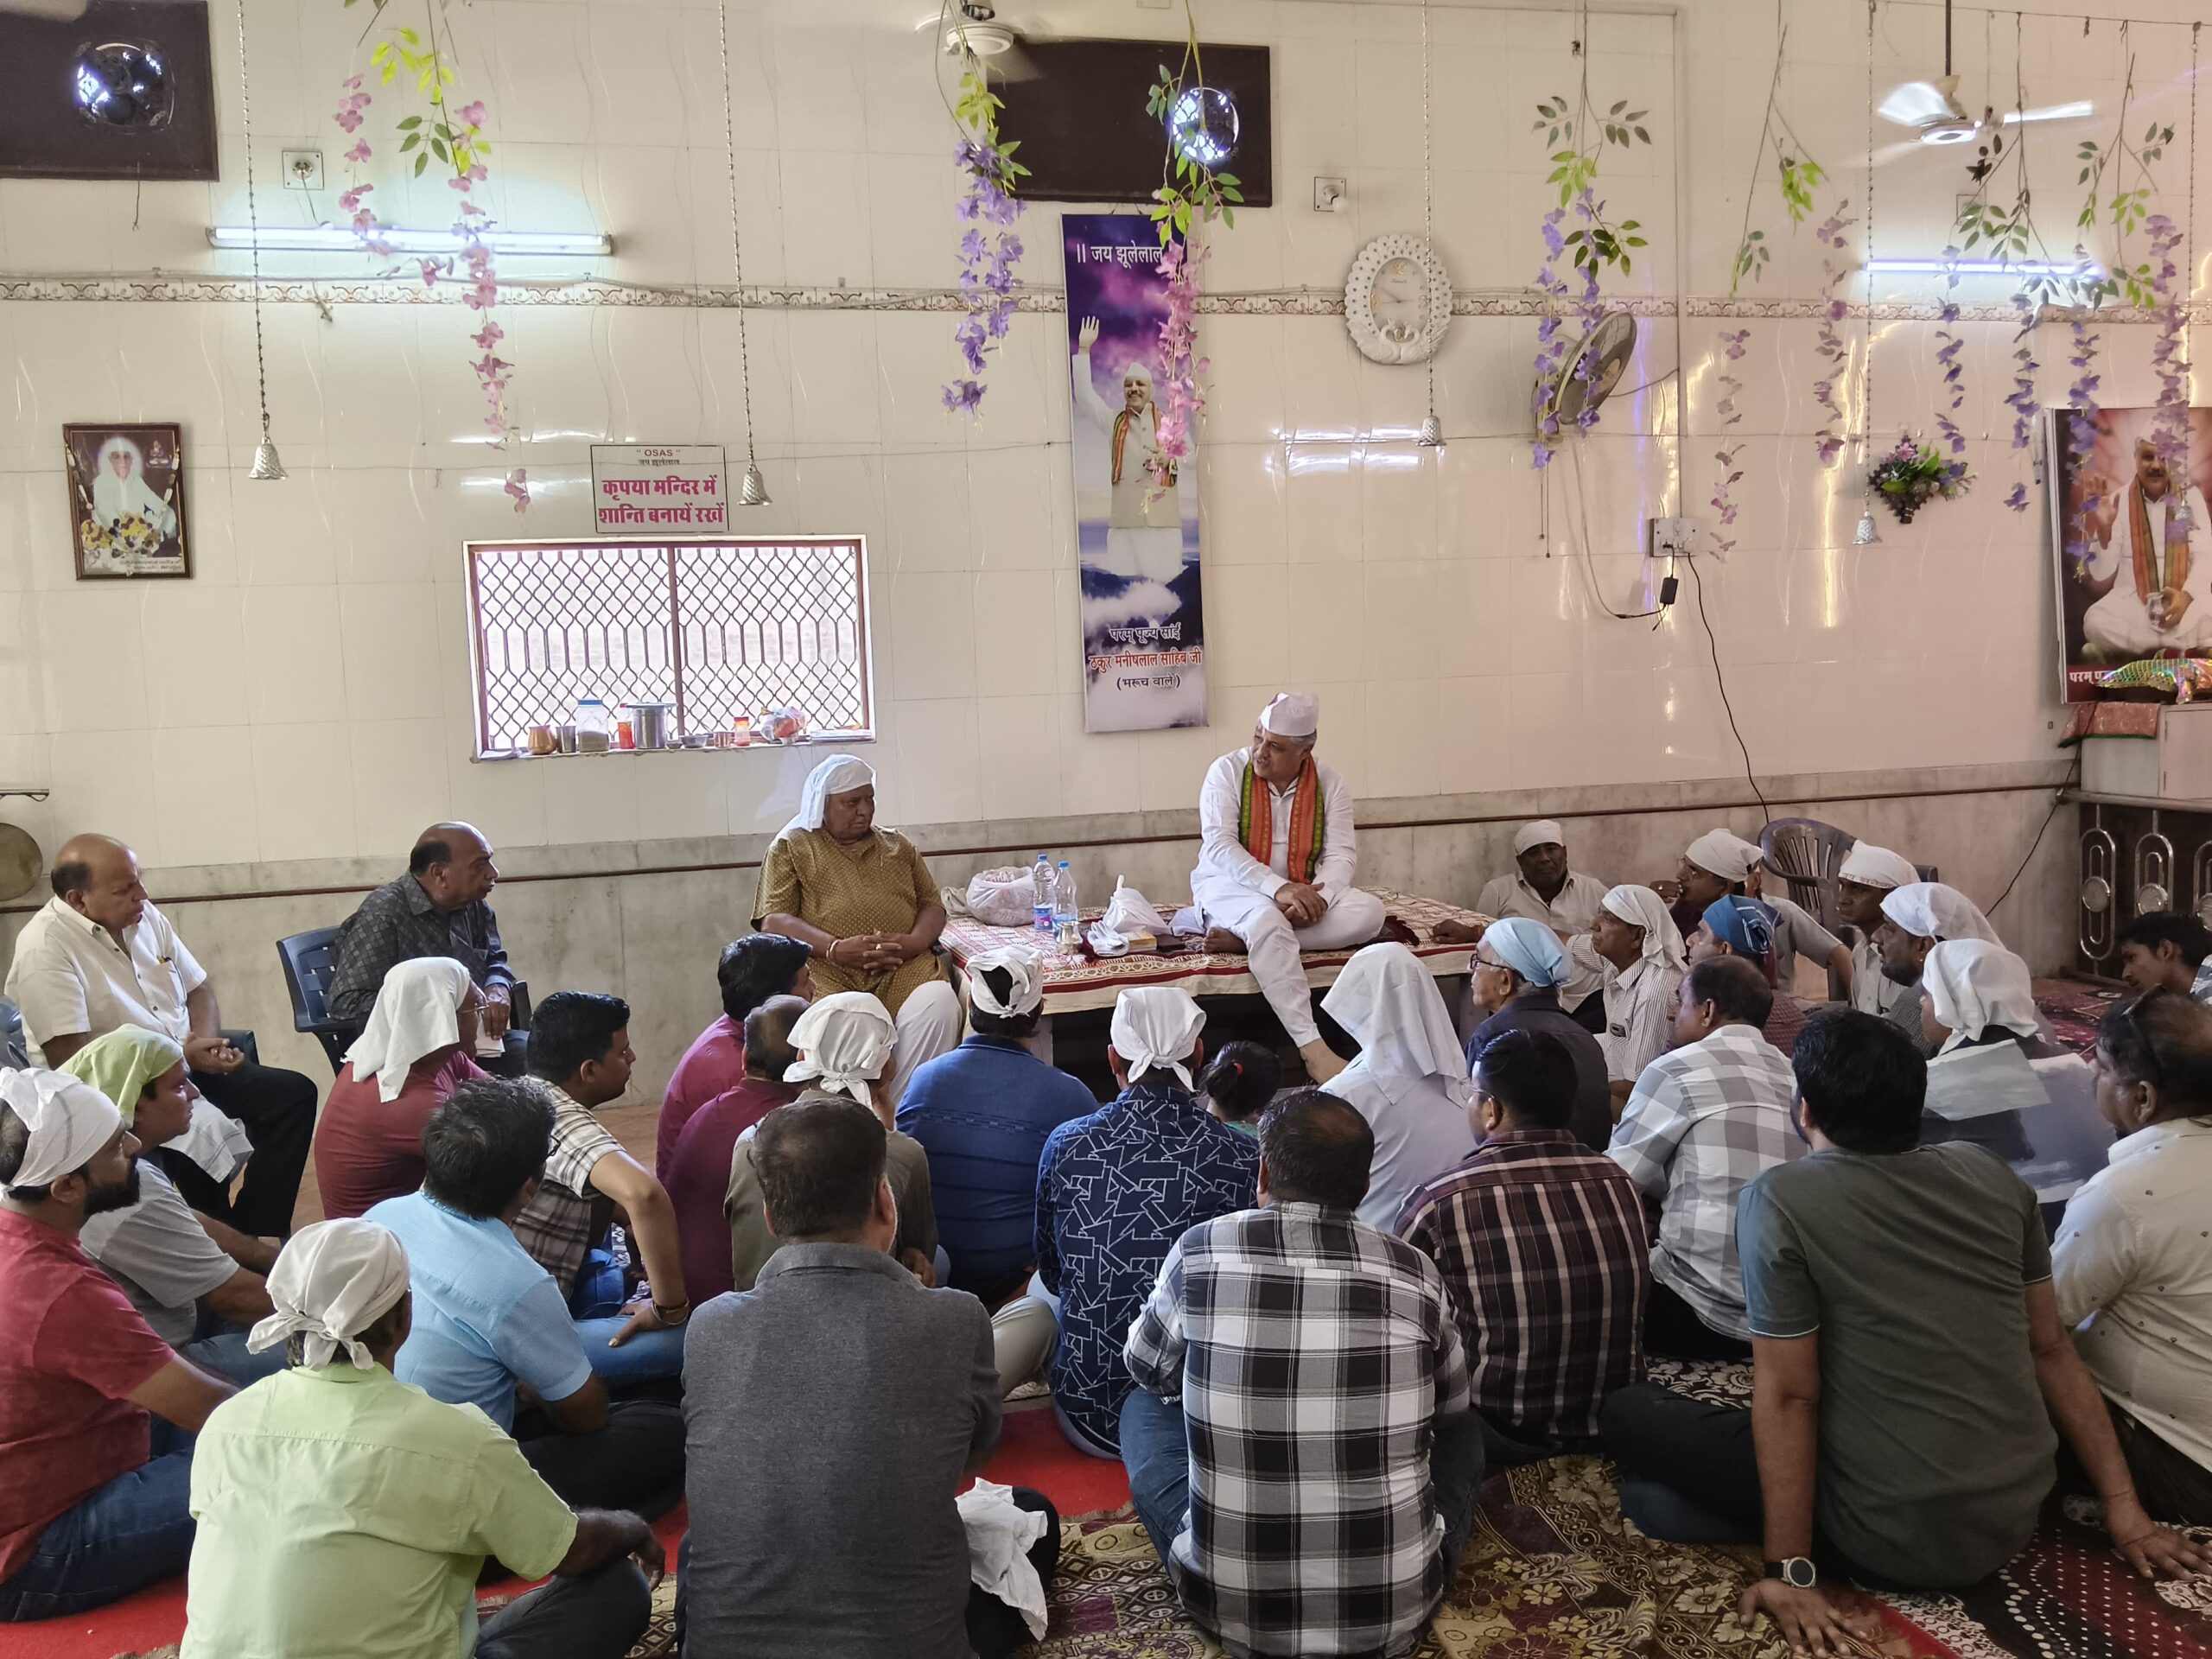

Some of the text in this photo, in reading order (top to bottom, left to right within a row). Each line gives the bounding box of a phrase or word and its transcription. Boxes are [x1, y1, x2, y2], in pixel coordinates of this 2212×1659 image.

[1090, 245, 1113, 263] जय
[1115, 239, 1163, 270] झूलेलाल
[644, 448, 674, 457] OSAS
[601, 474, 718, 501] कृपया मन्दिर में
[598, 502, 725, 524] शान्ति बनायें रखें
[1135, 626, 1159, 644] पूज्य
[1160, 645, 1187, 667] साहिब
[1189, 645, 1204, 664] जी
[2069, 671, 2094, 685] परम्
